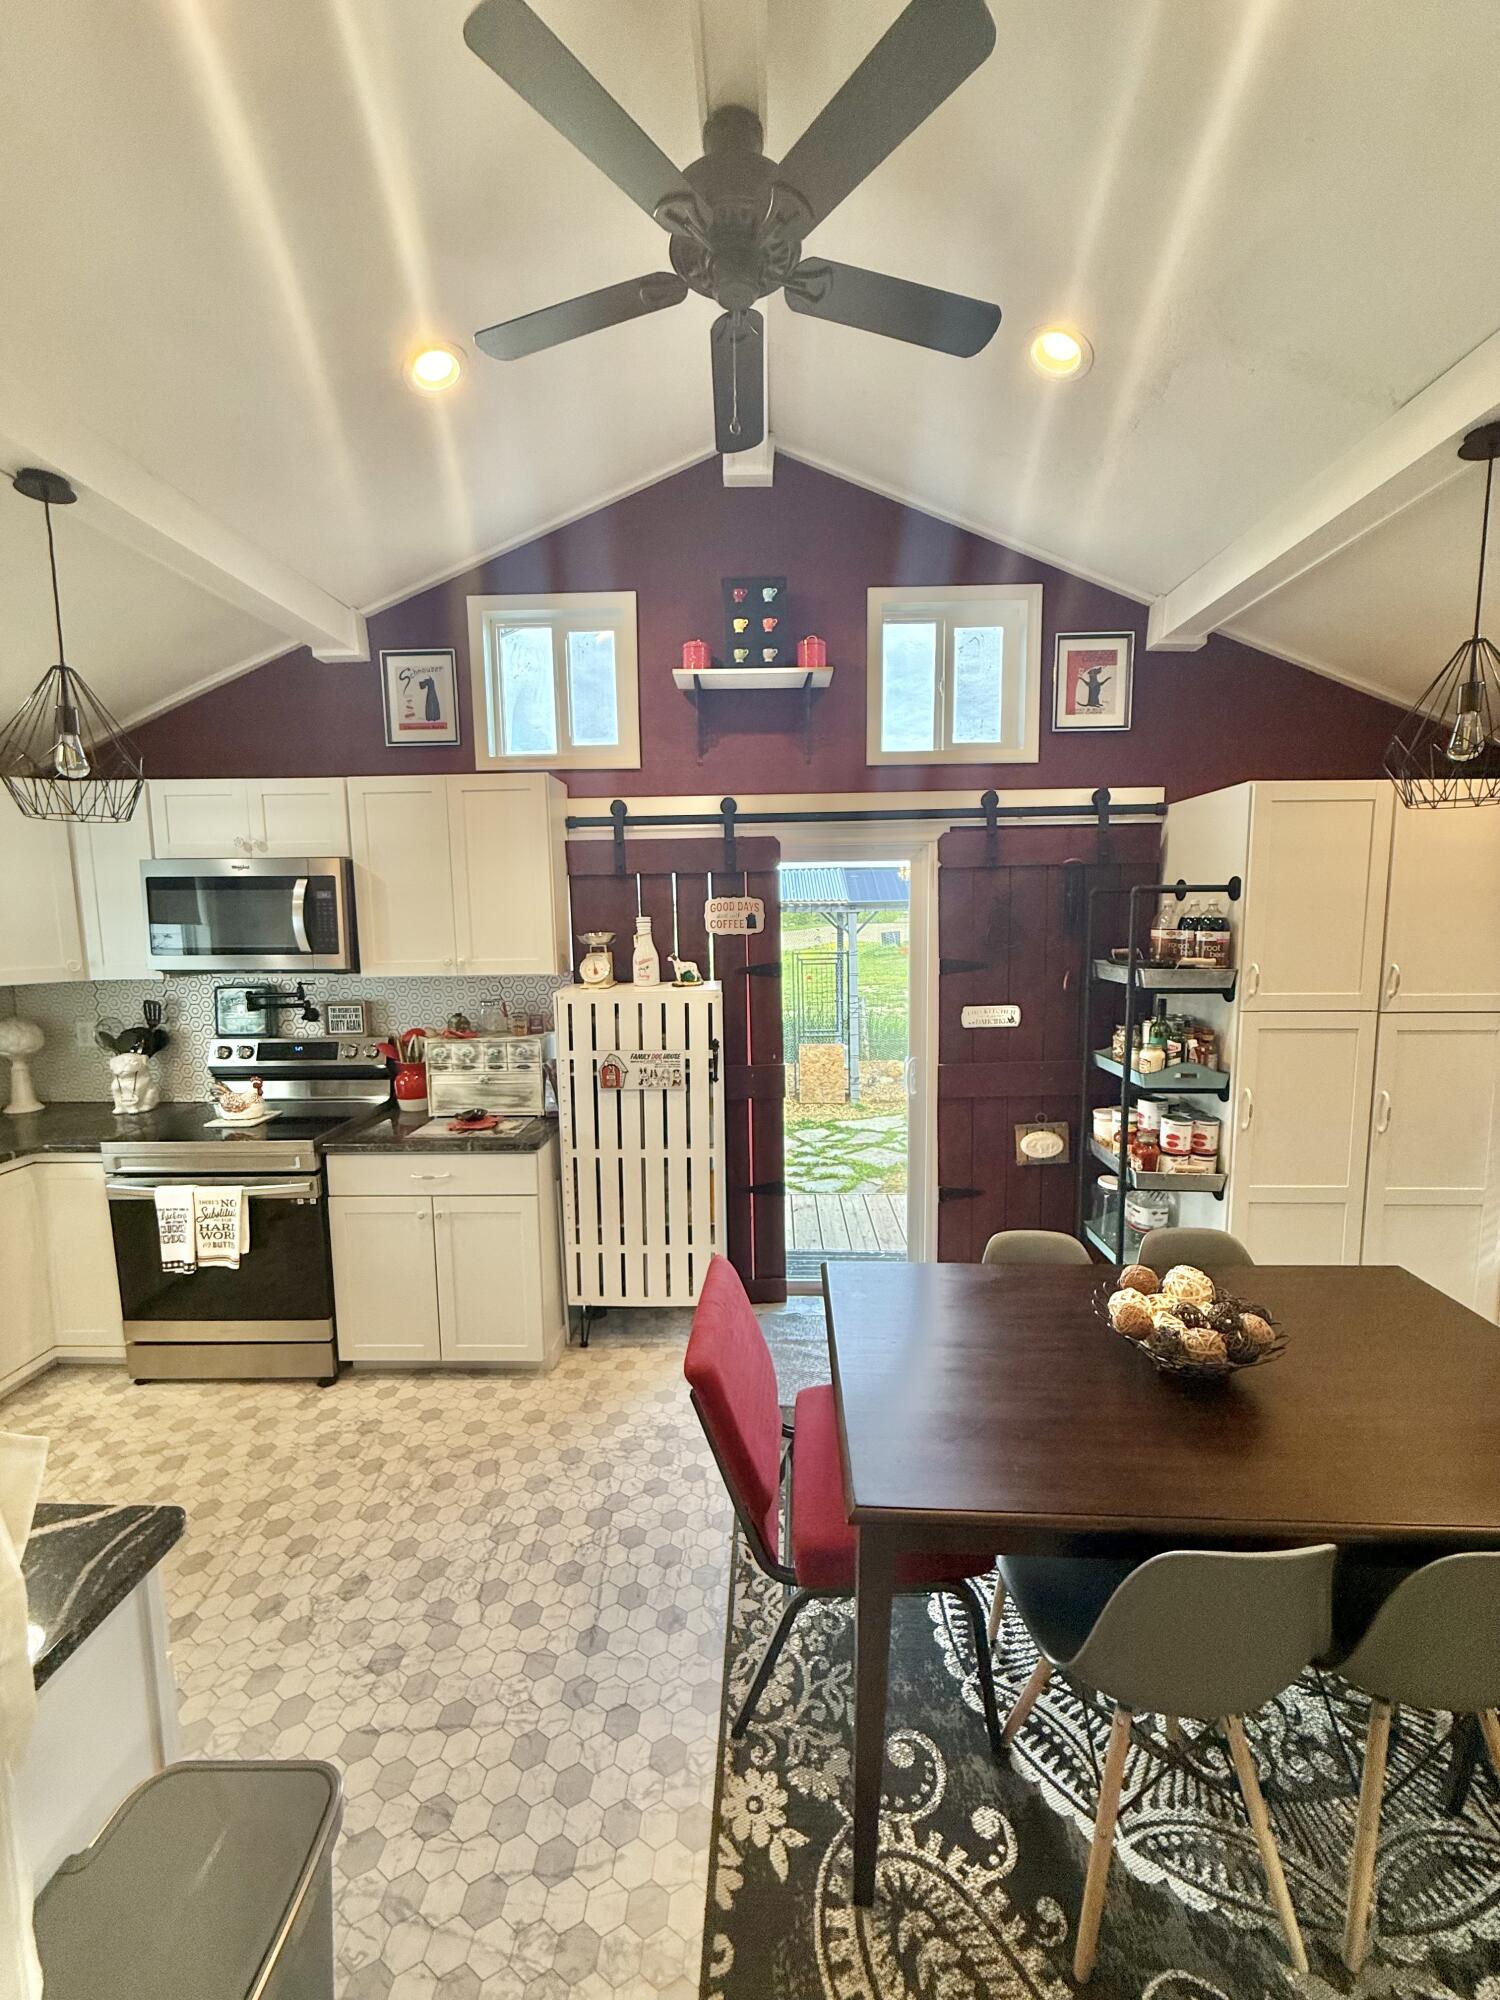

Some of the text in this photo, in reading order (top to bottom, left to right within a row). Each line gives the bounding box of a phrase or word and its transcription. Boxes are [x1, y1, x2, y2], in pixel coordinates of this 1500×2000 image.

[710, 901, 760, 912] GOOD DAYS
[710, 919, 745, 929] COFFEE
[331, 1020, 361, 1031] DIRTY AGAIN
